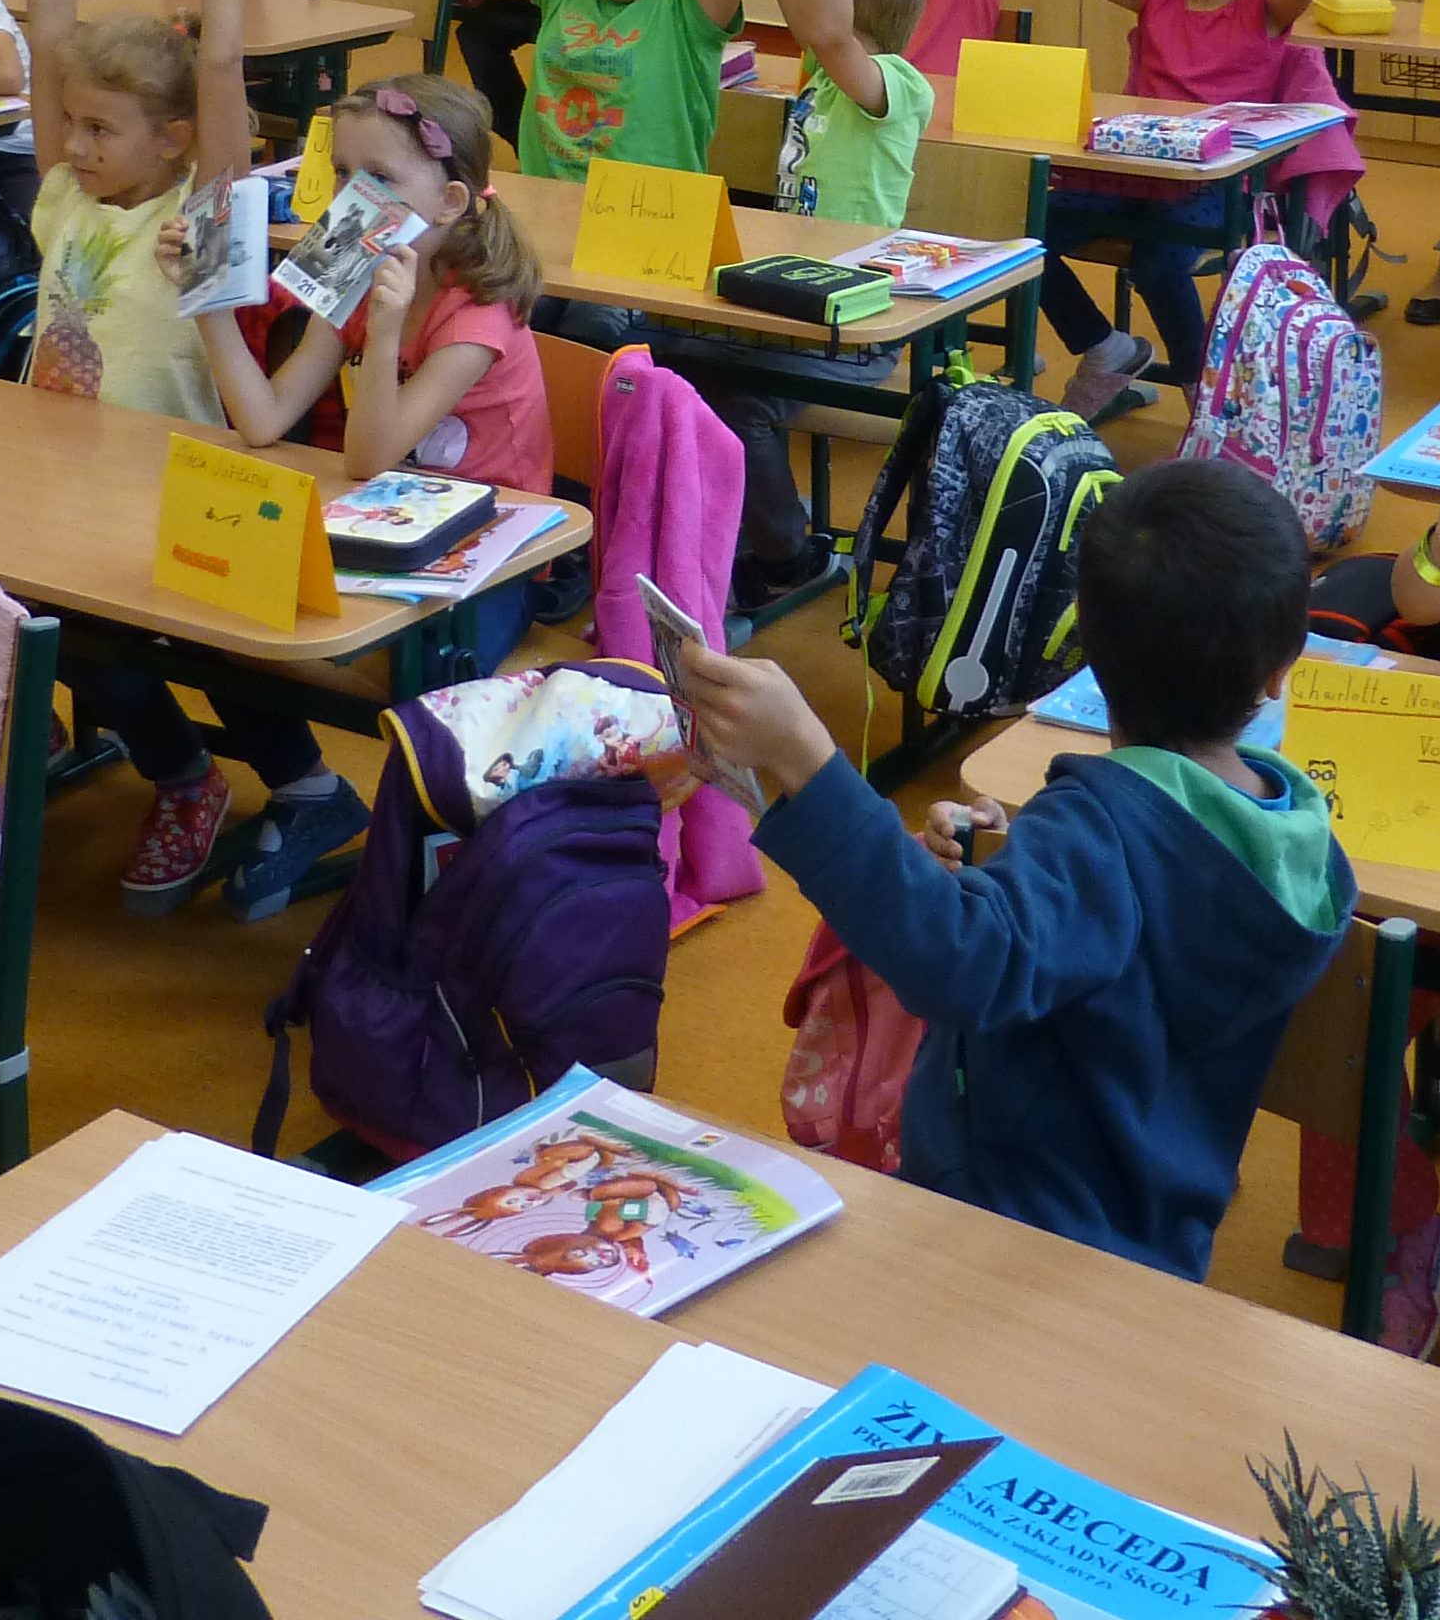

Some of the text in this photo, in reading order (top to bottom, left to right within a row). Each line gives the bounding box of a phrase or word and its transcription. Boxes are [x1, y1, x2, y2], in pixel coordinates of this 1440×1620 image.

[297, 279, 317, 298] 211
[984, 1477, 1211, 1591] ABECEDA
[1002, 1514, 1122, 1574] ZÁKLADNÍ
[1124, 1566, 1201, 1607] ŠKOLY
